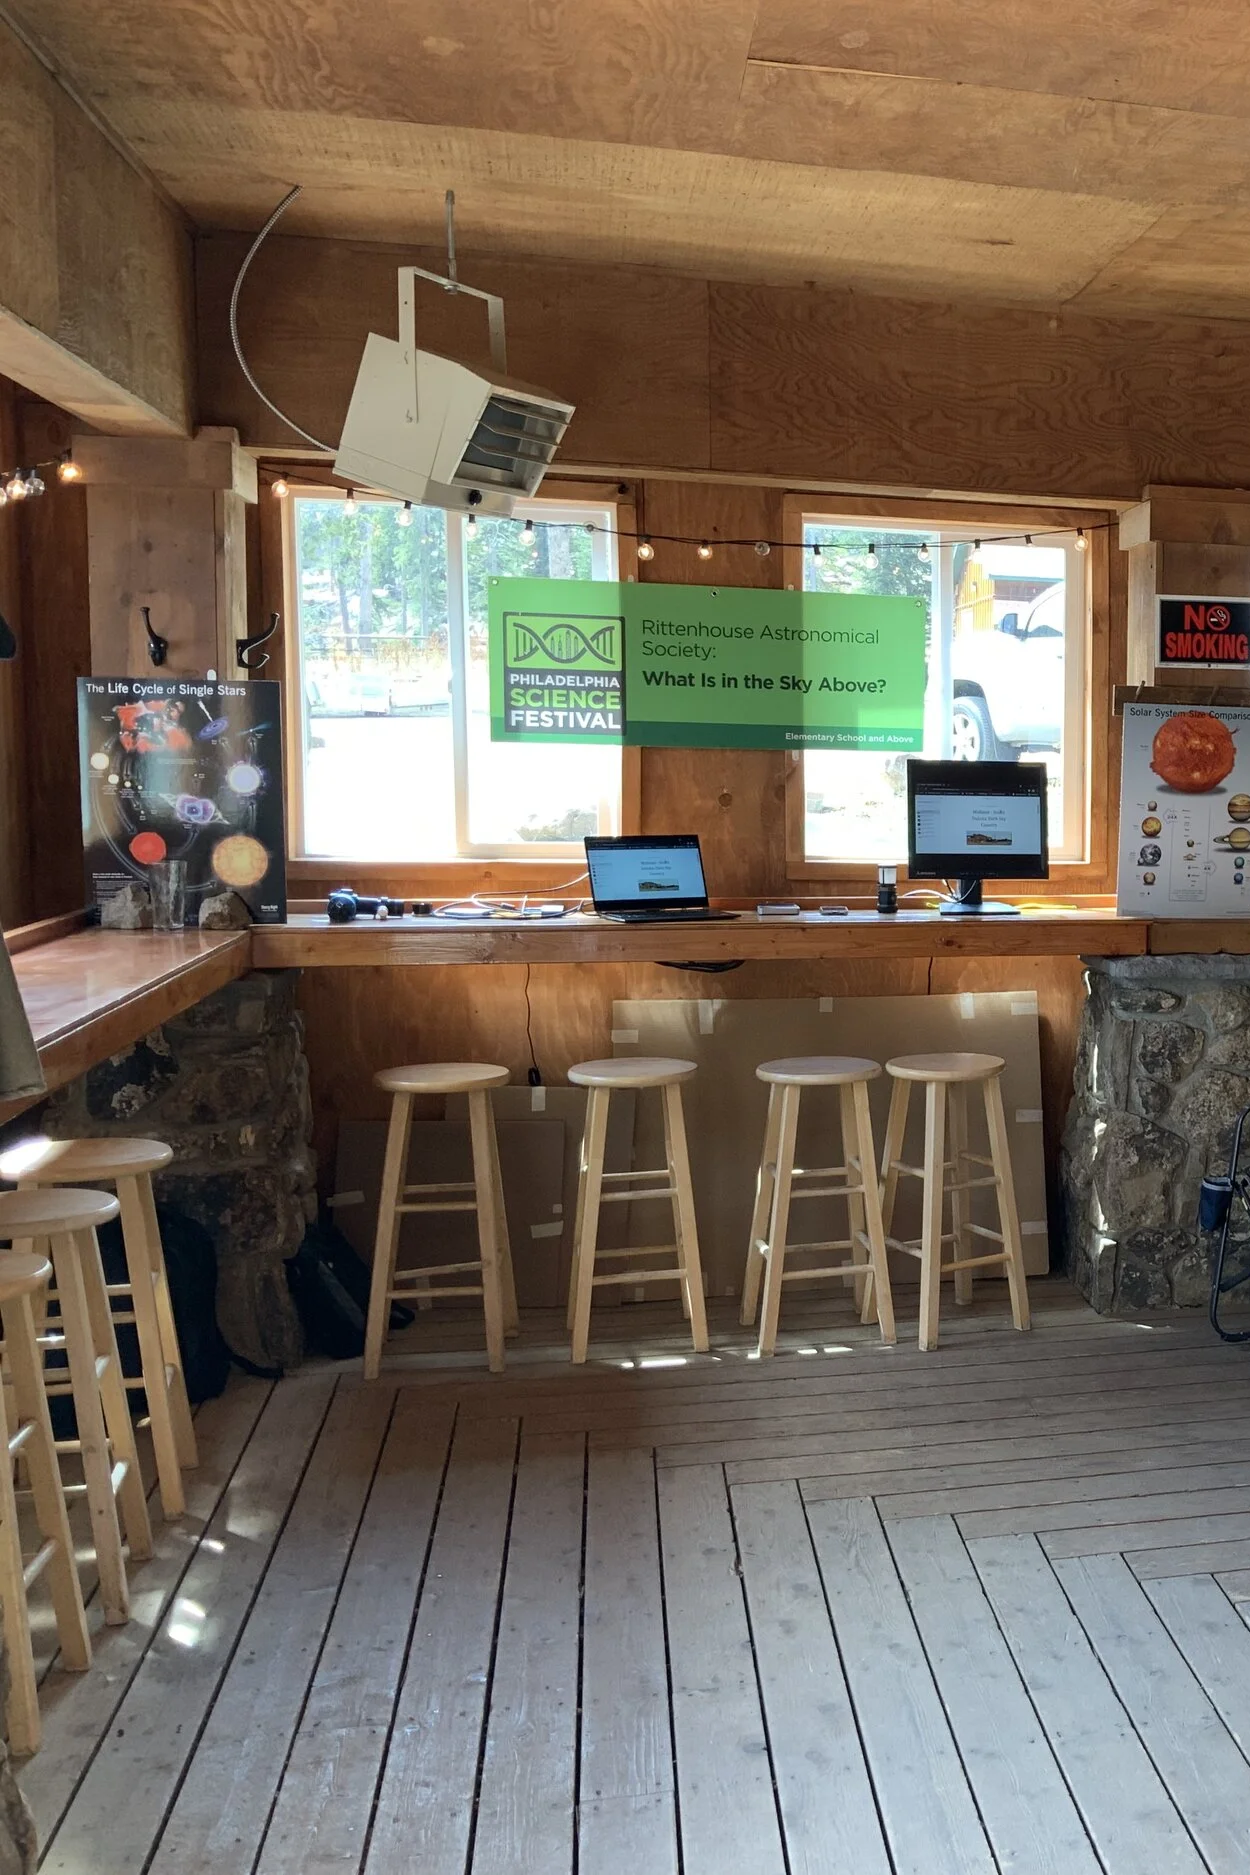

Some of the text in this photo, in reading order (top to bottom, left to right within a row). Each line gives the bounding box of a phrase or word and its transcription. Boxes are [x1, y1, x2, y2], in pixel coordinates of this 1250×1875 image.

[641, 619, 879, 645] Rittenhouse Astronomical
[641, 640, 717, 660] Society:
[1166, 632, 1249, 660] SMOKING
[86, 683, 246, 698] The Life Cycle of Single Stars
[510, 673, 620, 689] PHILADELPHIA
[642, 670, 887, 695] What Is in the Sky Above?
[510, 689, 621, 710] SCIENCE
[510, 710, 621, 730] FESTIVAL
[1130, 707, 1152, 717] Solar
[1155, 708, 1186, 720] System
[1189, 710, 1206, 719] Size
[785, 732, 914, 745] Elementary School and Above
